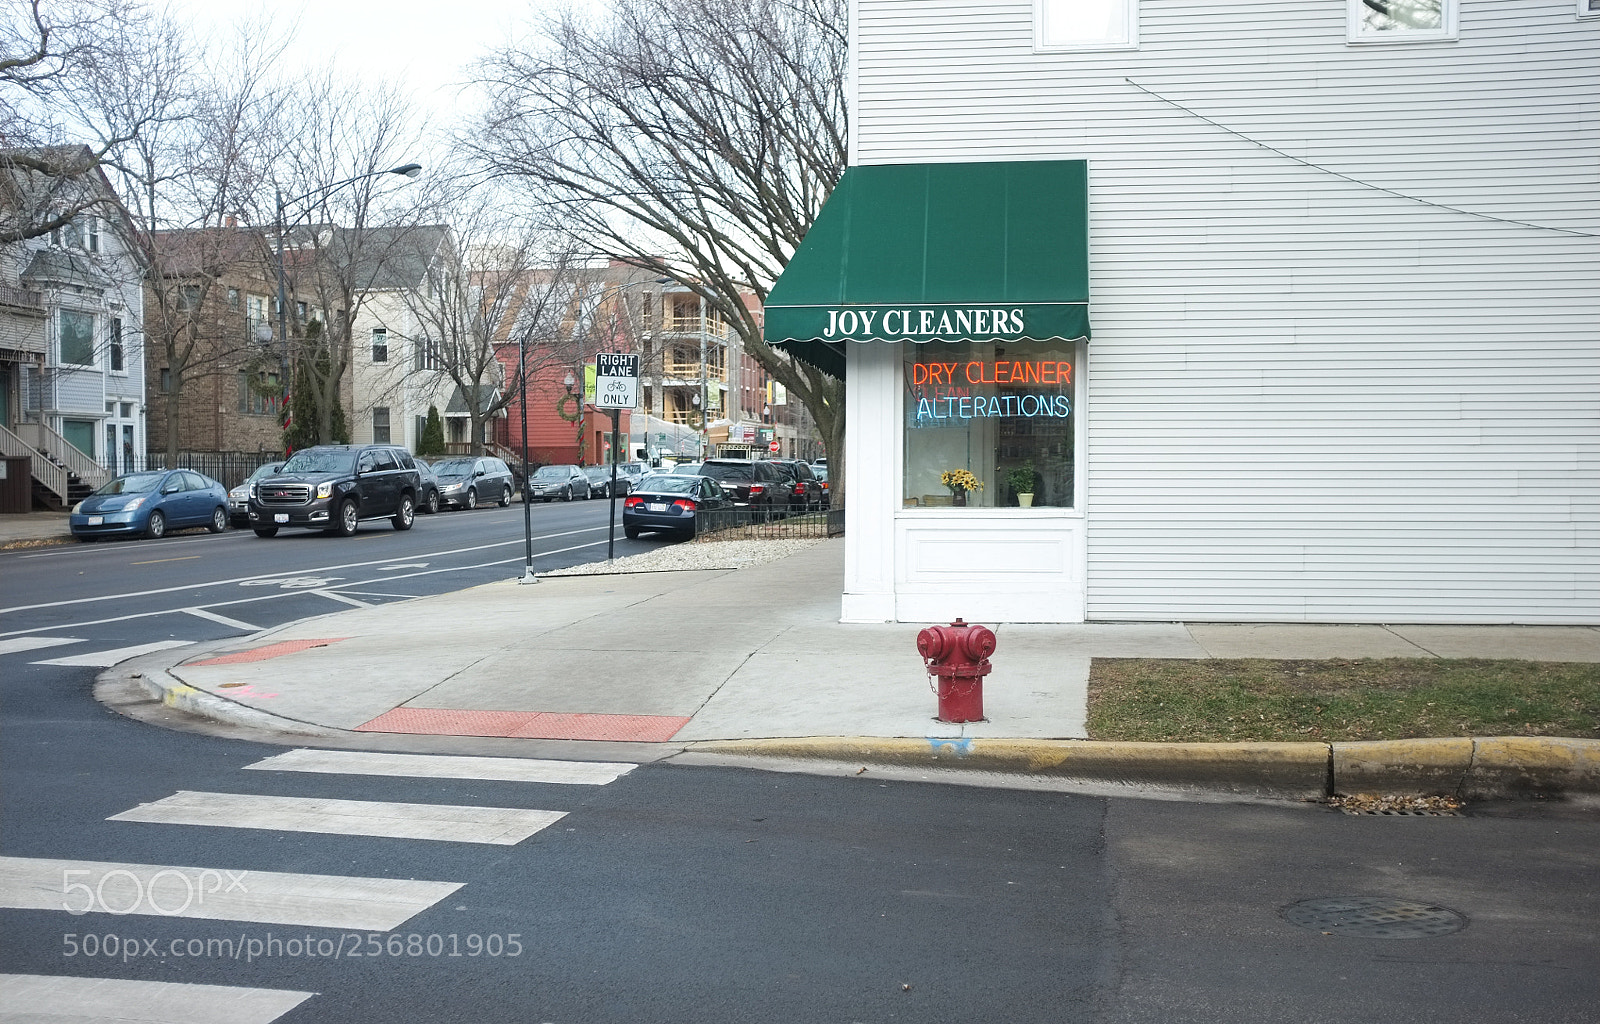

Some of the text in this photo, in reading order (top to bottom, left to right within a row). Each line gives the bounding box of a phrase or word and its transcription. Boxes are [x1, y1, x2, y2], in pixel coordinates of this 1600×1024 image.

[823, 308, 1025, 337] JOY CLEANERS
[600, 355, 634, 366] RIGHT
[601, 366, 633, 377] LANE
[913, 361, 1072, 385] DRY CLEANER
[603, 393, 629, 405] ONLY
[916, 394, 1070, 420] ALTERATIONS
